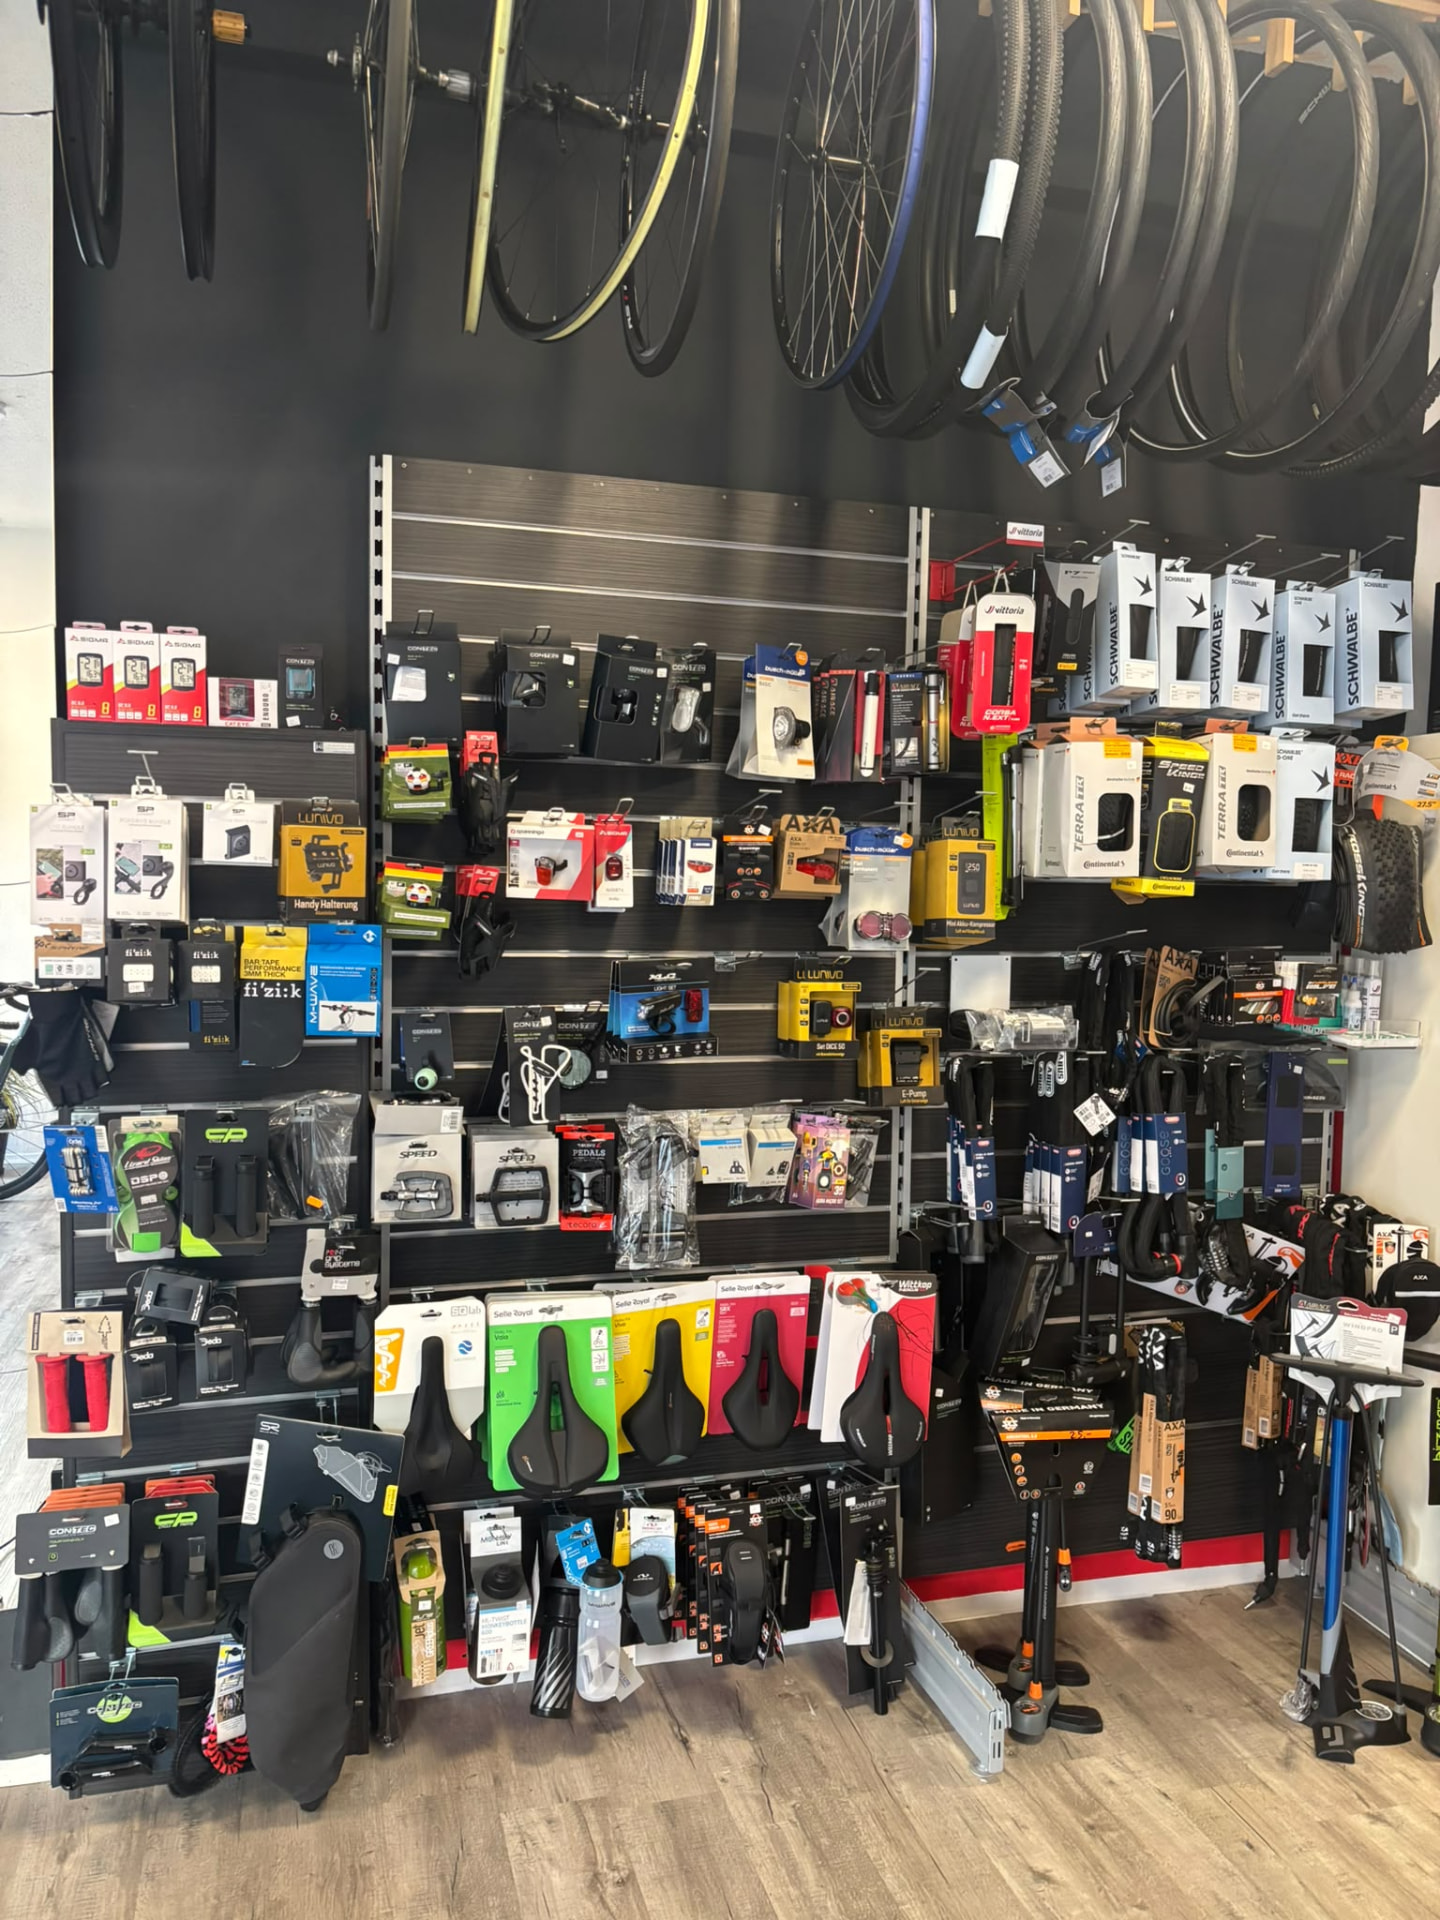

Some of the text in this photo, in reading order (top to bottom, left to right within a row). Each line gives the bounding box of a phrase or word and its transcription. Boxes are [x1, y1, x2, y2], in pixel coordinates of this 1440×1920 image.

[1017, 526, 1043, 537] vittoria
[1164, 575, 1193, 583] SCHWALBE
[1231, 578, 1258, 588] SCHWALBE
[1363, 580, 1390, 589] SCHWALBE
[994, 605, 1025, 615] vittoria
[1109, 604, 1119, 686] SCHWALBE
[1210, 608, 1224, 705] SCHWALBE
[1347, 611, 1359, 706] SCHWALBE
[1275, 634, 1286, 720] SCHWALBE
[101, 702, 110, 715] 8
[148, 704, 156, 717] 8
[193, 706, 202, 718] 8
[298, 812, 344, 825] LUNIVO
[1218, 790, 1226, 840] TERRA
[785, 814, 836, 834] AXA
[1074, 803, 1084, 853] TERRA
[944, 828, 979, 837] LUNIVO
[1226, 848, 1258, 858] Continental
[1083, 861, 1120, 870] Continental
[1152, 883, 1181, 891] Continental
[294, 899, 358, 912] Handy Halterung
[1164, 952, 1194, 974] AXA
[807, 970, 844, 980] LUNIVO
[243, 982, 302, 998] fi'zi:k
[310, 964, 318, 1024] M-WAVE
[888, 1016, 924, 1027] LUNIVO
[902, 1090, 928, 1099] E-Pump
[400, 1150, 438, 1159] SPEED
[498, 1154, 536, 1163] SPEED
[1120, 1132, 1130, 1176] GOOSE
[1160, 1131, 1171, 1176] GOOSE
[124, 1159, 150, 1170] Lizard
[130, 1174, 158, 1186] DSP
[737, 1284, 754, 1293] Royal
[899, 1280, 932, 1290] Wittkop
[632, 1298, 650, 1307] Royal
[494, 1309, 534, 1318] Selle Royal
[200, 1336, 222, 1348] Deda
[130, 1352, 154, 1363] Deda
[984, 1376, 1018, 1385] MADE
[1046, 1403, 1104, 1412] GERMANY
[1164, 1422, 1186, 1430] AXA
[1164, 1508, 1177, 1520] 90
[48, 1524, 97, 1536] CONTEC
